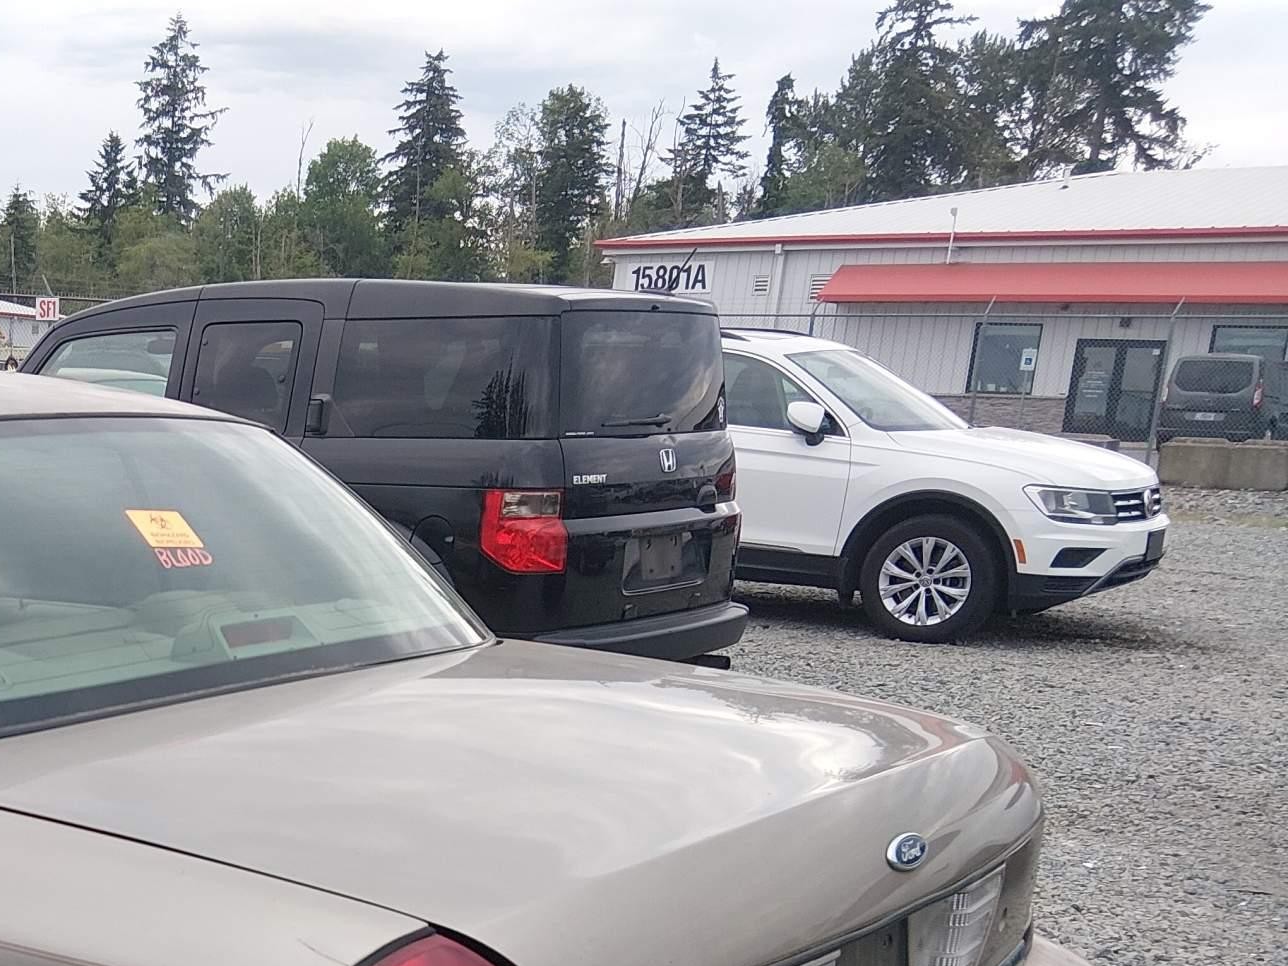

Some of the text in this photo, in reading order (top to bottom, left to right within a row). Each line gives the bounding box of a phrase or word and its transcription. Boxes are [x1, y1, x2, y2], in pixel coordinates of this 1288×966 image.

[632, 263, 707, 291] 15801A
[39, 300, 57, 318] SF1
[573, 474, 608, 485] ELEMENT
[154, 548, 213, 568] BLOOD
[900, 839, 922, 862] Ford
